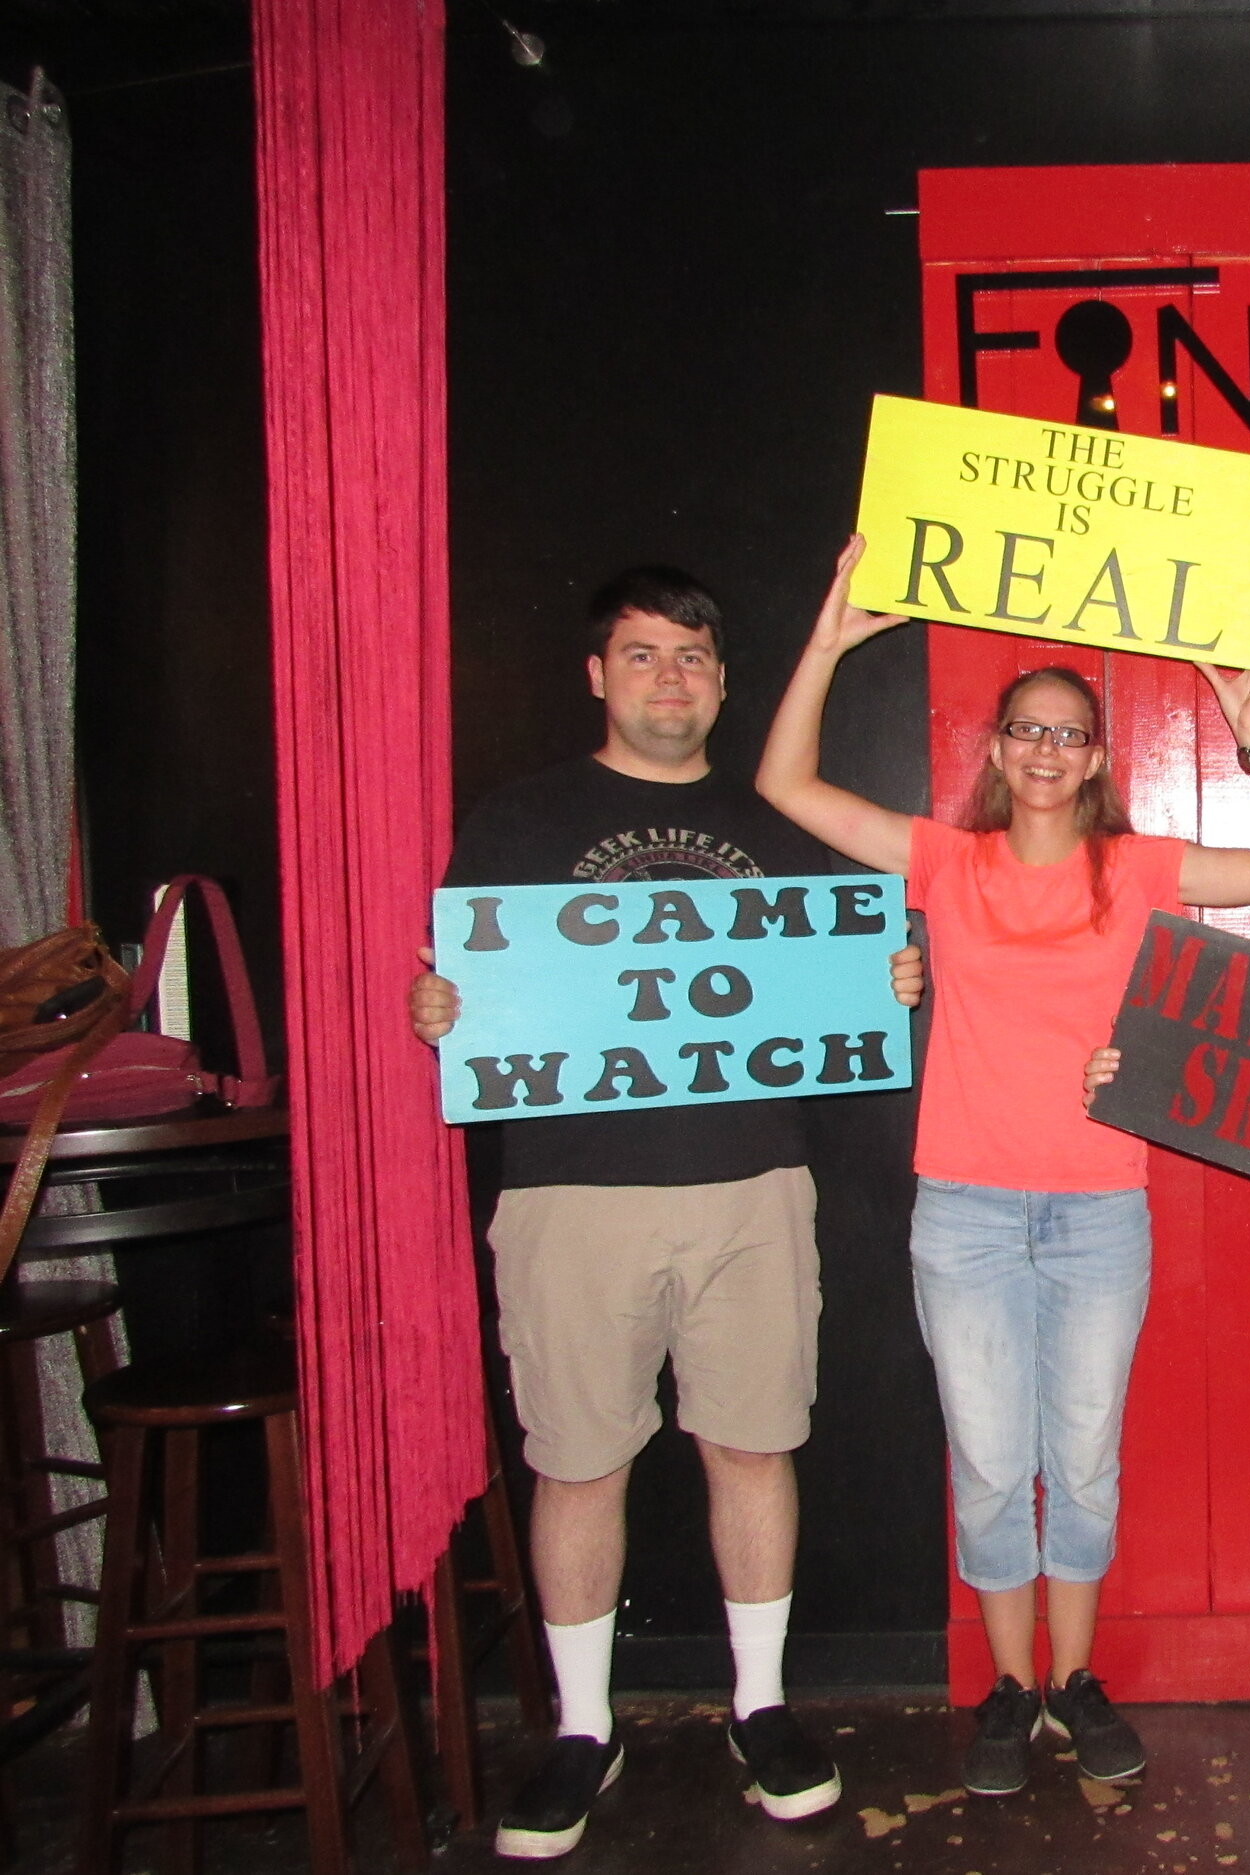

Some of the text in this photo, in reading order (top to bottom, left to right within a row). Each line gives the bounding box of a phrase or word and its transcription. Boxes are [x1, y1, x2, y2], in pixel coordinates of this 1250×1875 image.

[1041, 427, 1126, 469] THE
[960, 451, 1194, 517] STRUGGLE
[1054, 502, 1091, 536] IS
[895, 516, 1223, 653] REAL
[572, 830, 642, 878] GEEK
[648, 828, 714, 848] LIFE
[463, 884, 886, 951] I CAME
[618, 965, 753, 1021] TO
[465, 1031, 894, 1110] WATCH
